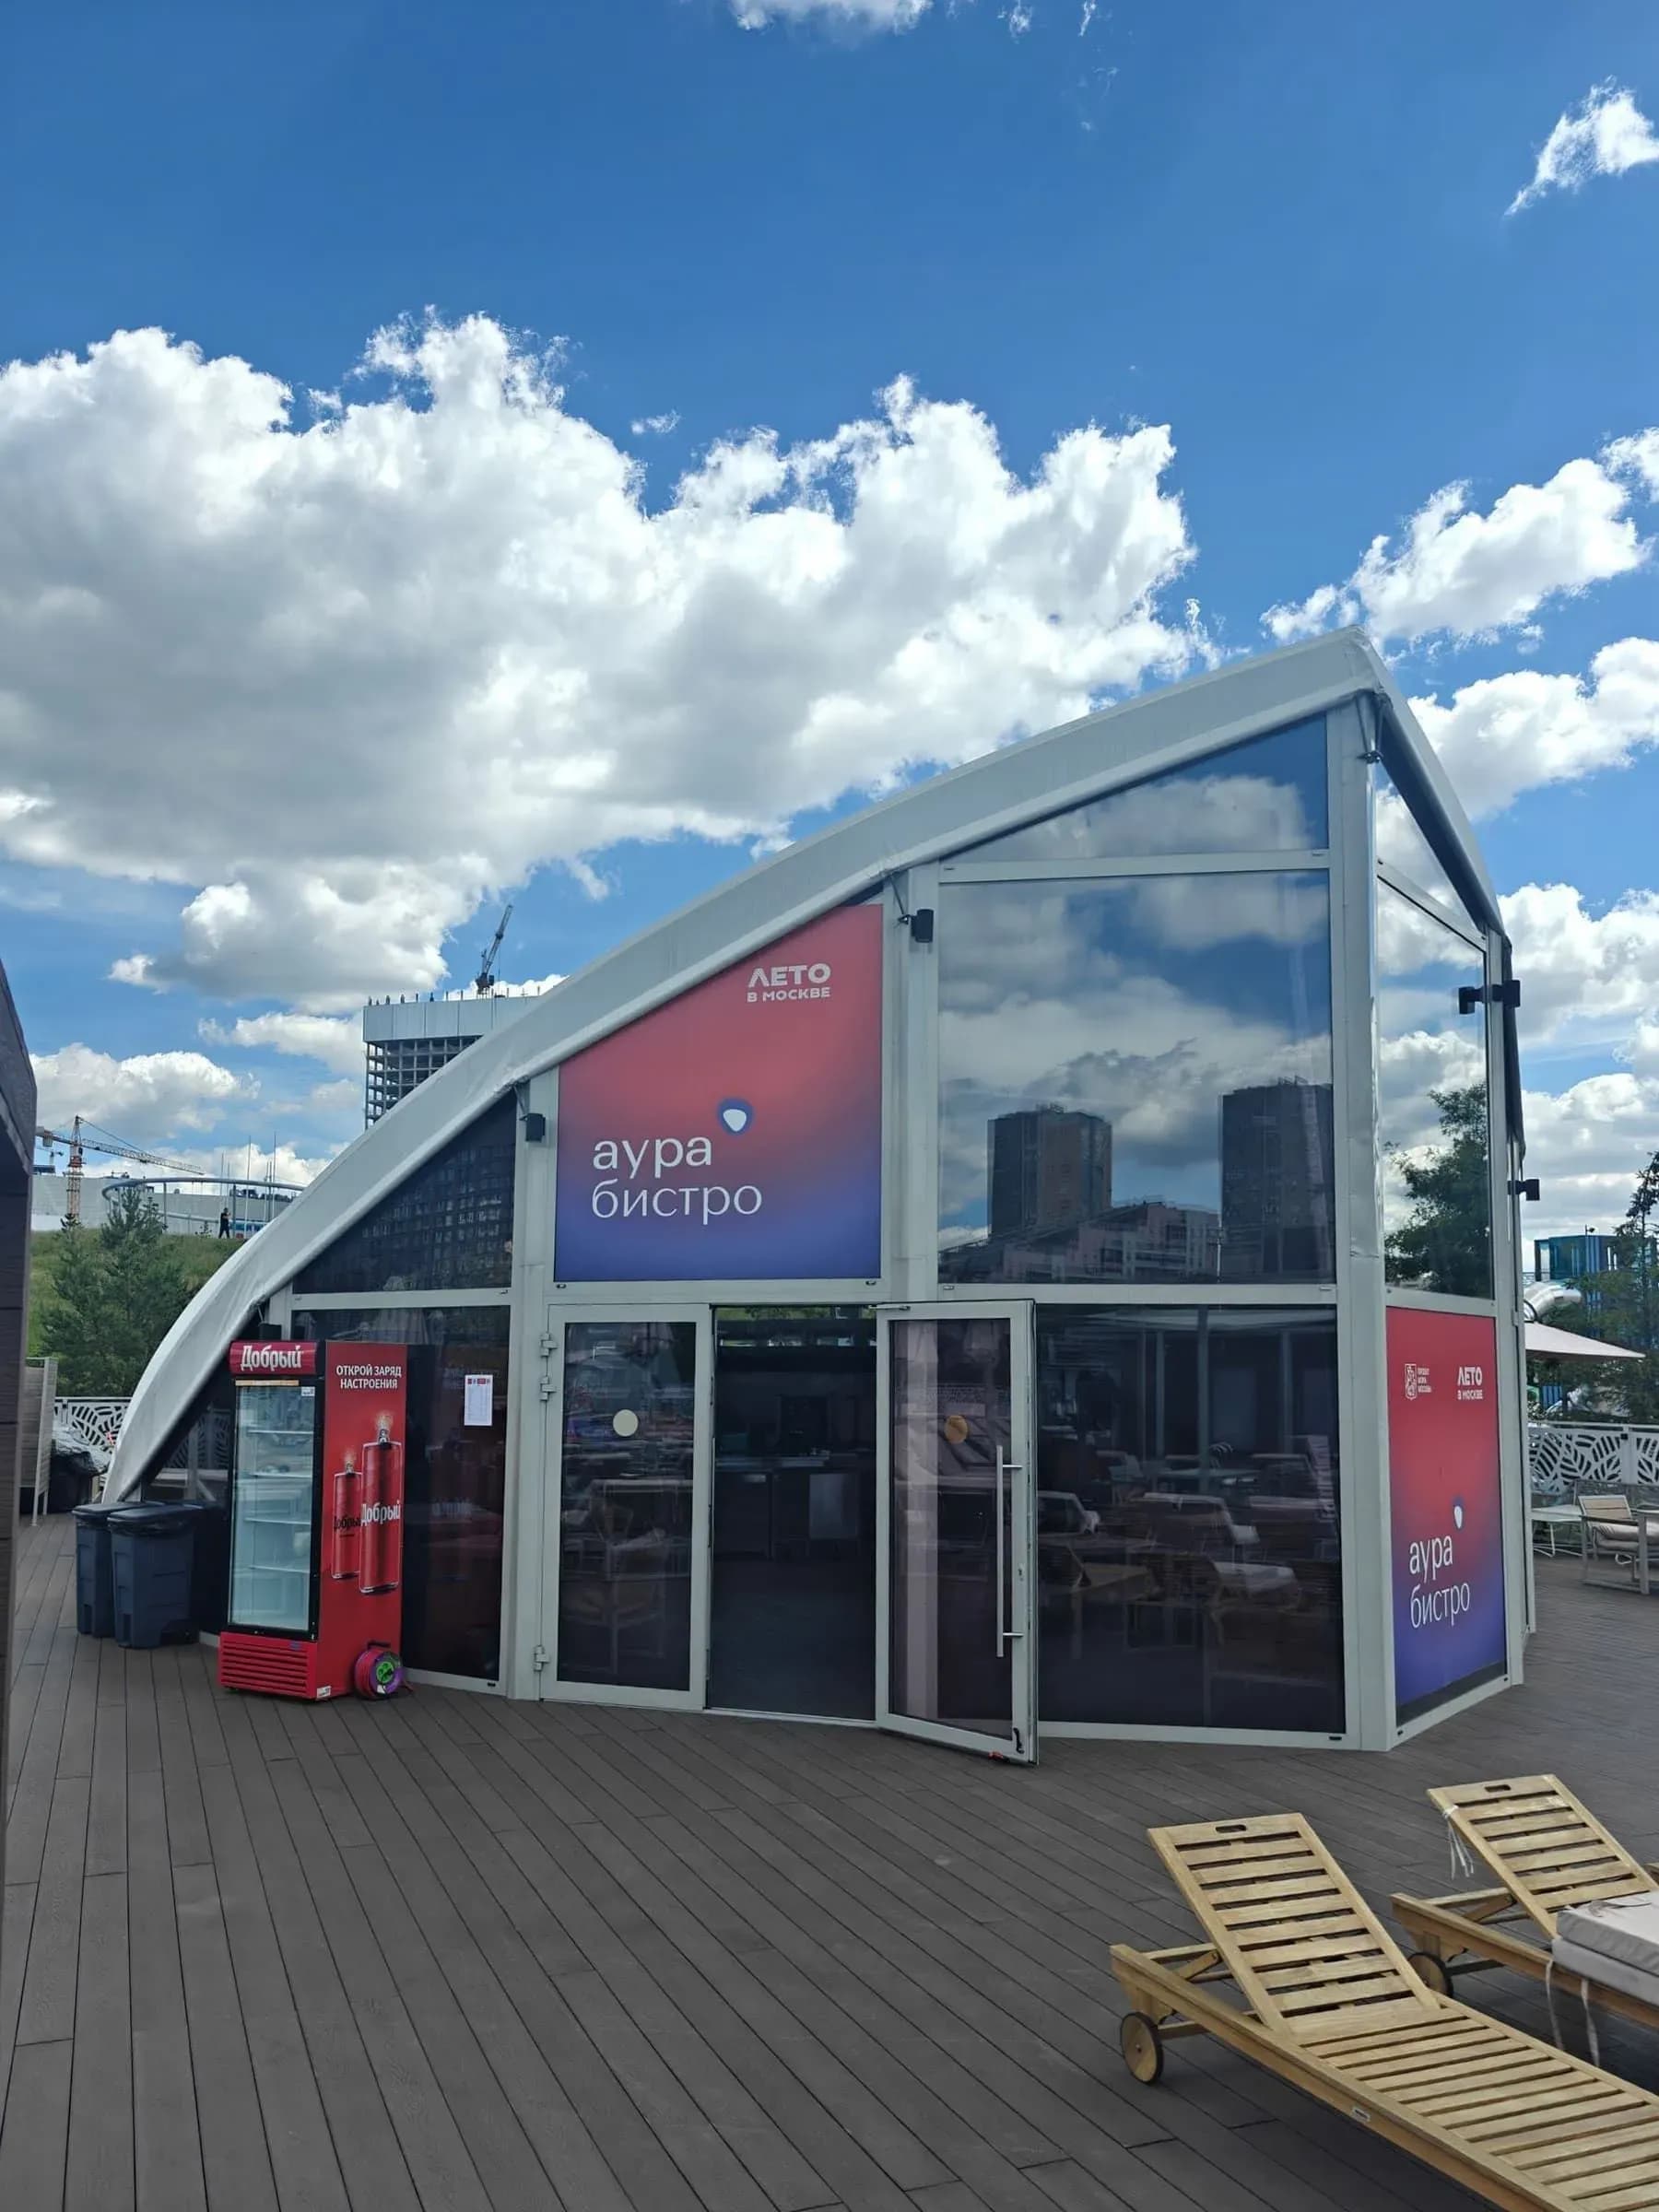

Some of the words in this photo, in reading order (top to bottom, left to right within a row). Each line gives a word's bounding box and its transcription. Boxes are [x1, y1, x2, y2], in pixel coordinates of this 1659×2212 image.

[748, 963, 831, 988] ЛЕТО
[747, 991, 758, 1003] В
[762, 987, 831, 1002] МОСКВЕ
[593, 1136, 712, 1179] аура
[592, 1178, 762, 1225] бистро
[241, 1345, 302, 1371] Добрый
[336, 1364, 374, 1376] ОТКРОЙ
[374, 1366, 402, 1377] ЗАРЯД
[340, 1379, 398, 1389] НАСТРОЕНИЯ
[1457, 1367, 1482, 1386] ЛЕТО
[360, 1500, 401, 1526] Добрый
[1409, 1535, 1453, 1583] аура
[1410, 1583, 1470, 1629] бистро
